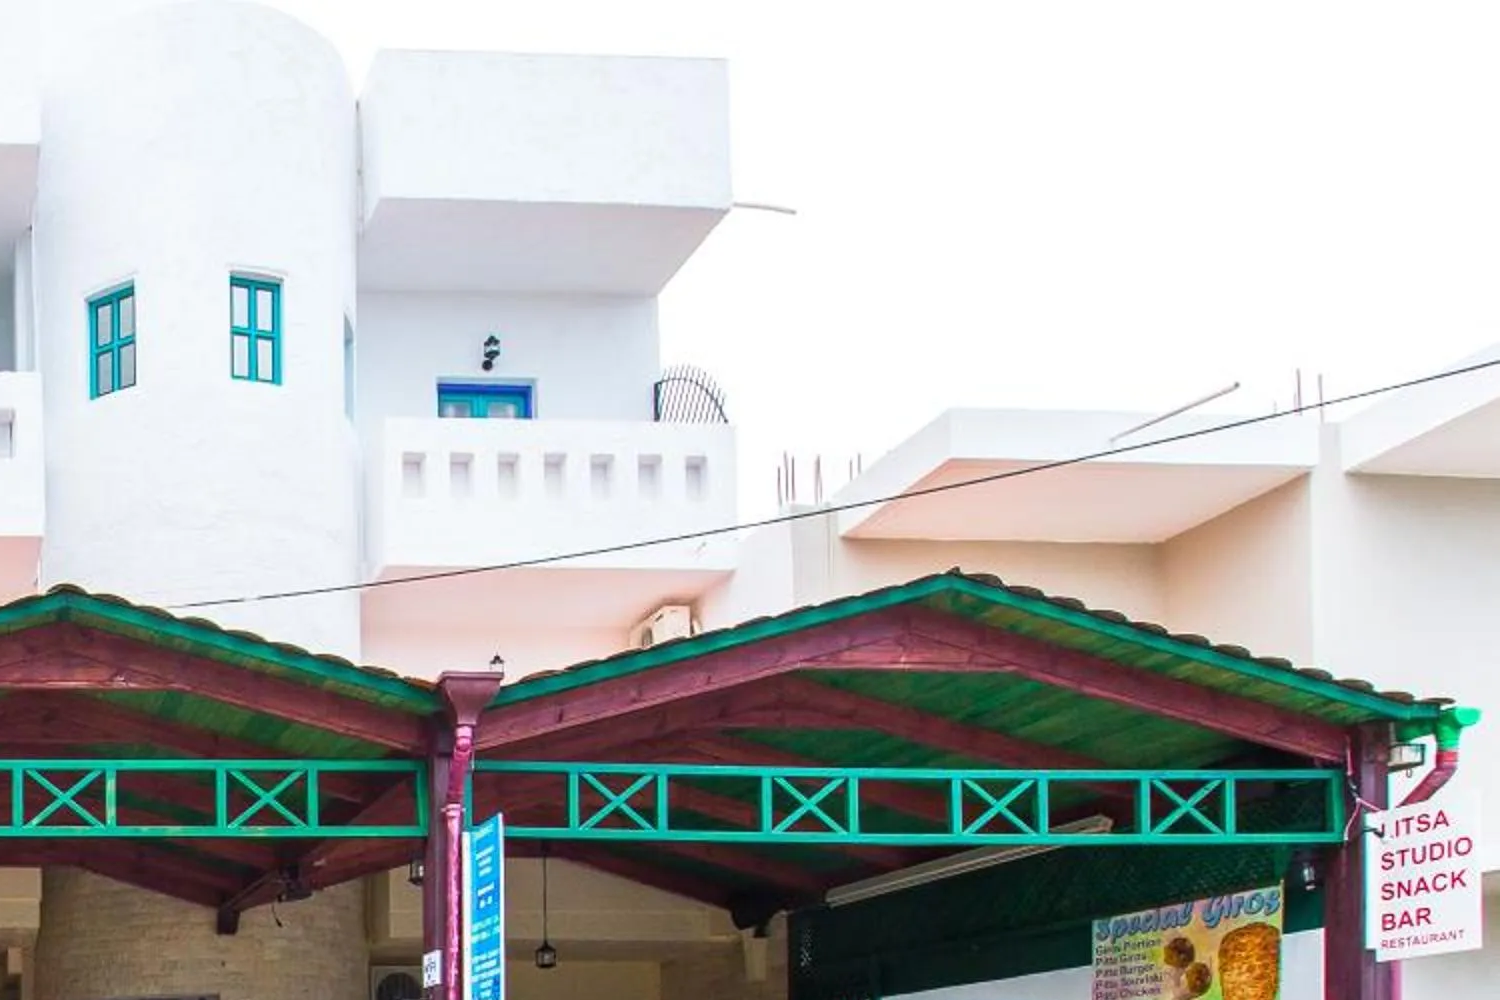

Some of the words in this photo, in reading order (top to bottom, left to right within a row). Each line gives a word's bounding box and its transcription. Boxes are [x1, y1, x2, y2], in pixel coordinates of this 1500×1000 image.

[1381, 836, 1474, 871] STUDIO
[1381, 869, 1467, 901] SNACK
[1095, 901, 1194, 943] Special
[1202, 888, 1281, 928] Giros
[1381, 907, 1432, 932] BAR
[1381, 929, 1465, 949] RESTAURANT
